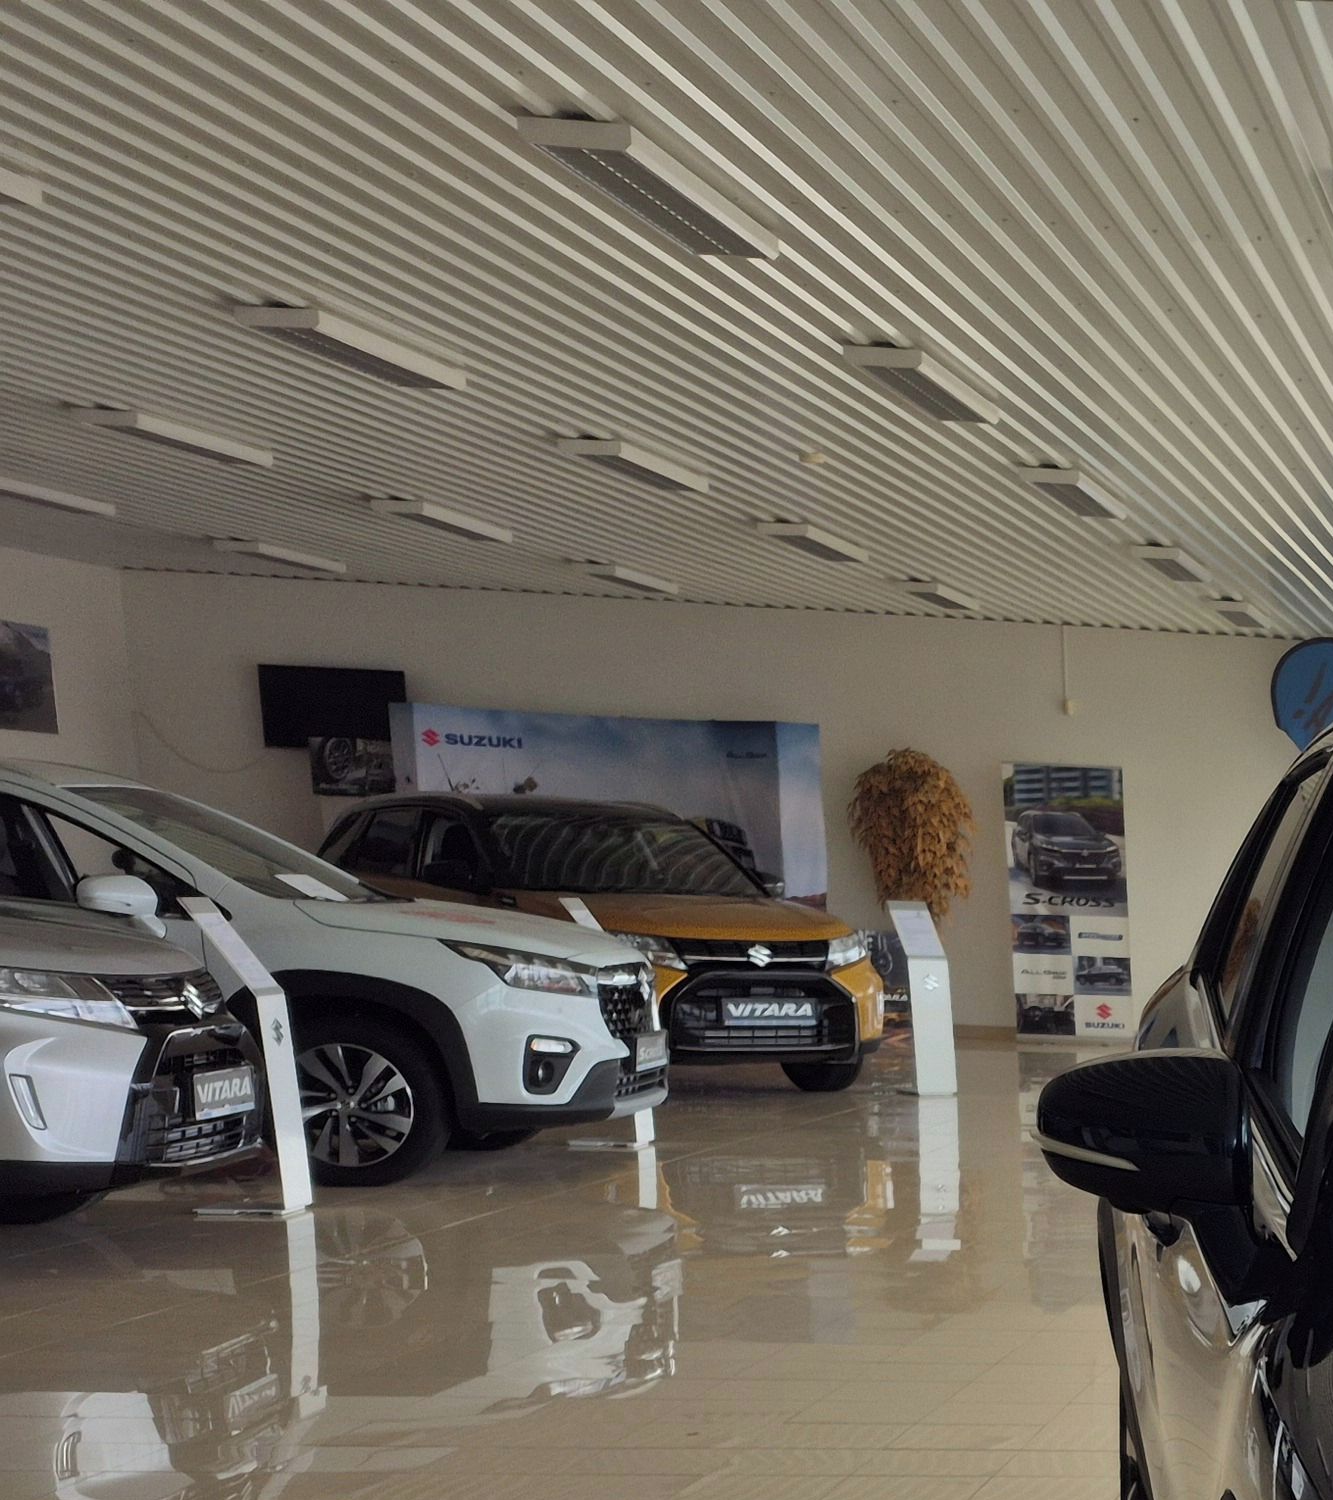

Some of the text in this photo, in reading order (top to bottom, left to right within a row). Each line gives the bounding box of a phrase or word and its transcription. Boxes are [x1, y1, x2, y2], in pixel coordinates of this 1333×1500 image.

[444, 733, 523, 749] SUZUKI
[727, 1003, 813, 1017] VITARA
[197, 1076, 251, 1103] VITARA
